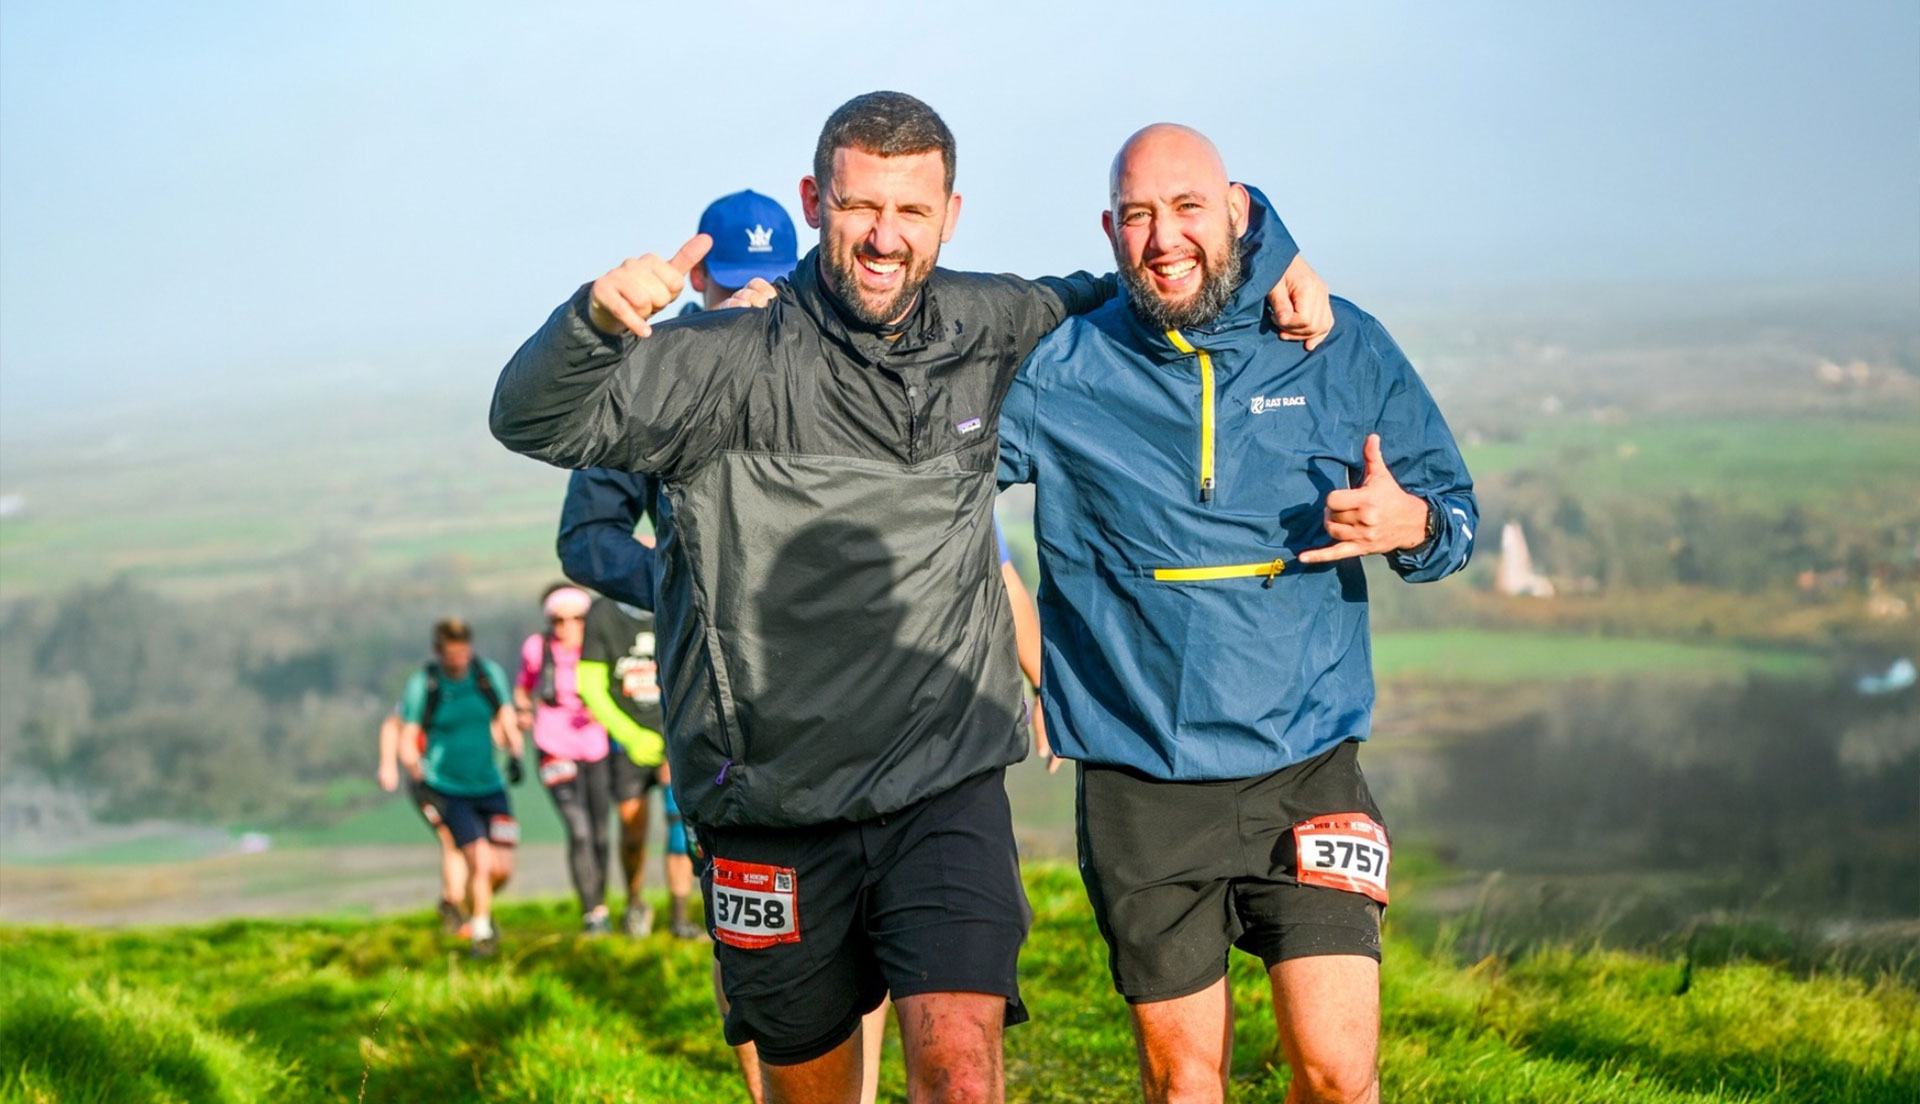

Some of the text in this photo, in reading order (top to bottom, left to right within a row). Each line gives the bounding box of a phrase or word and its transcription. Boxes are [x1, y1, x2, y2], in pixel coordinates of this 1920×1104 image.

[1265, 396, 1306, 407] RAT RACE
[1315, 840, 1384, 877] 3757
[716, 891, 785, 929] 3758
